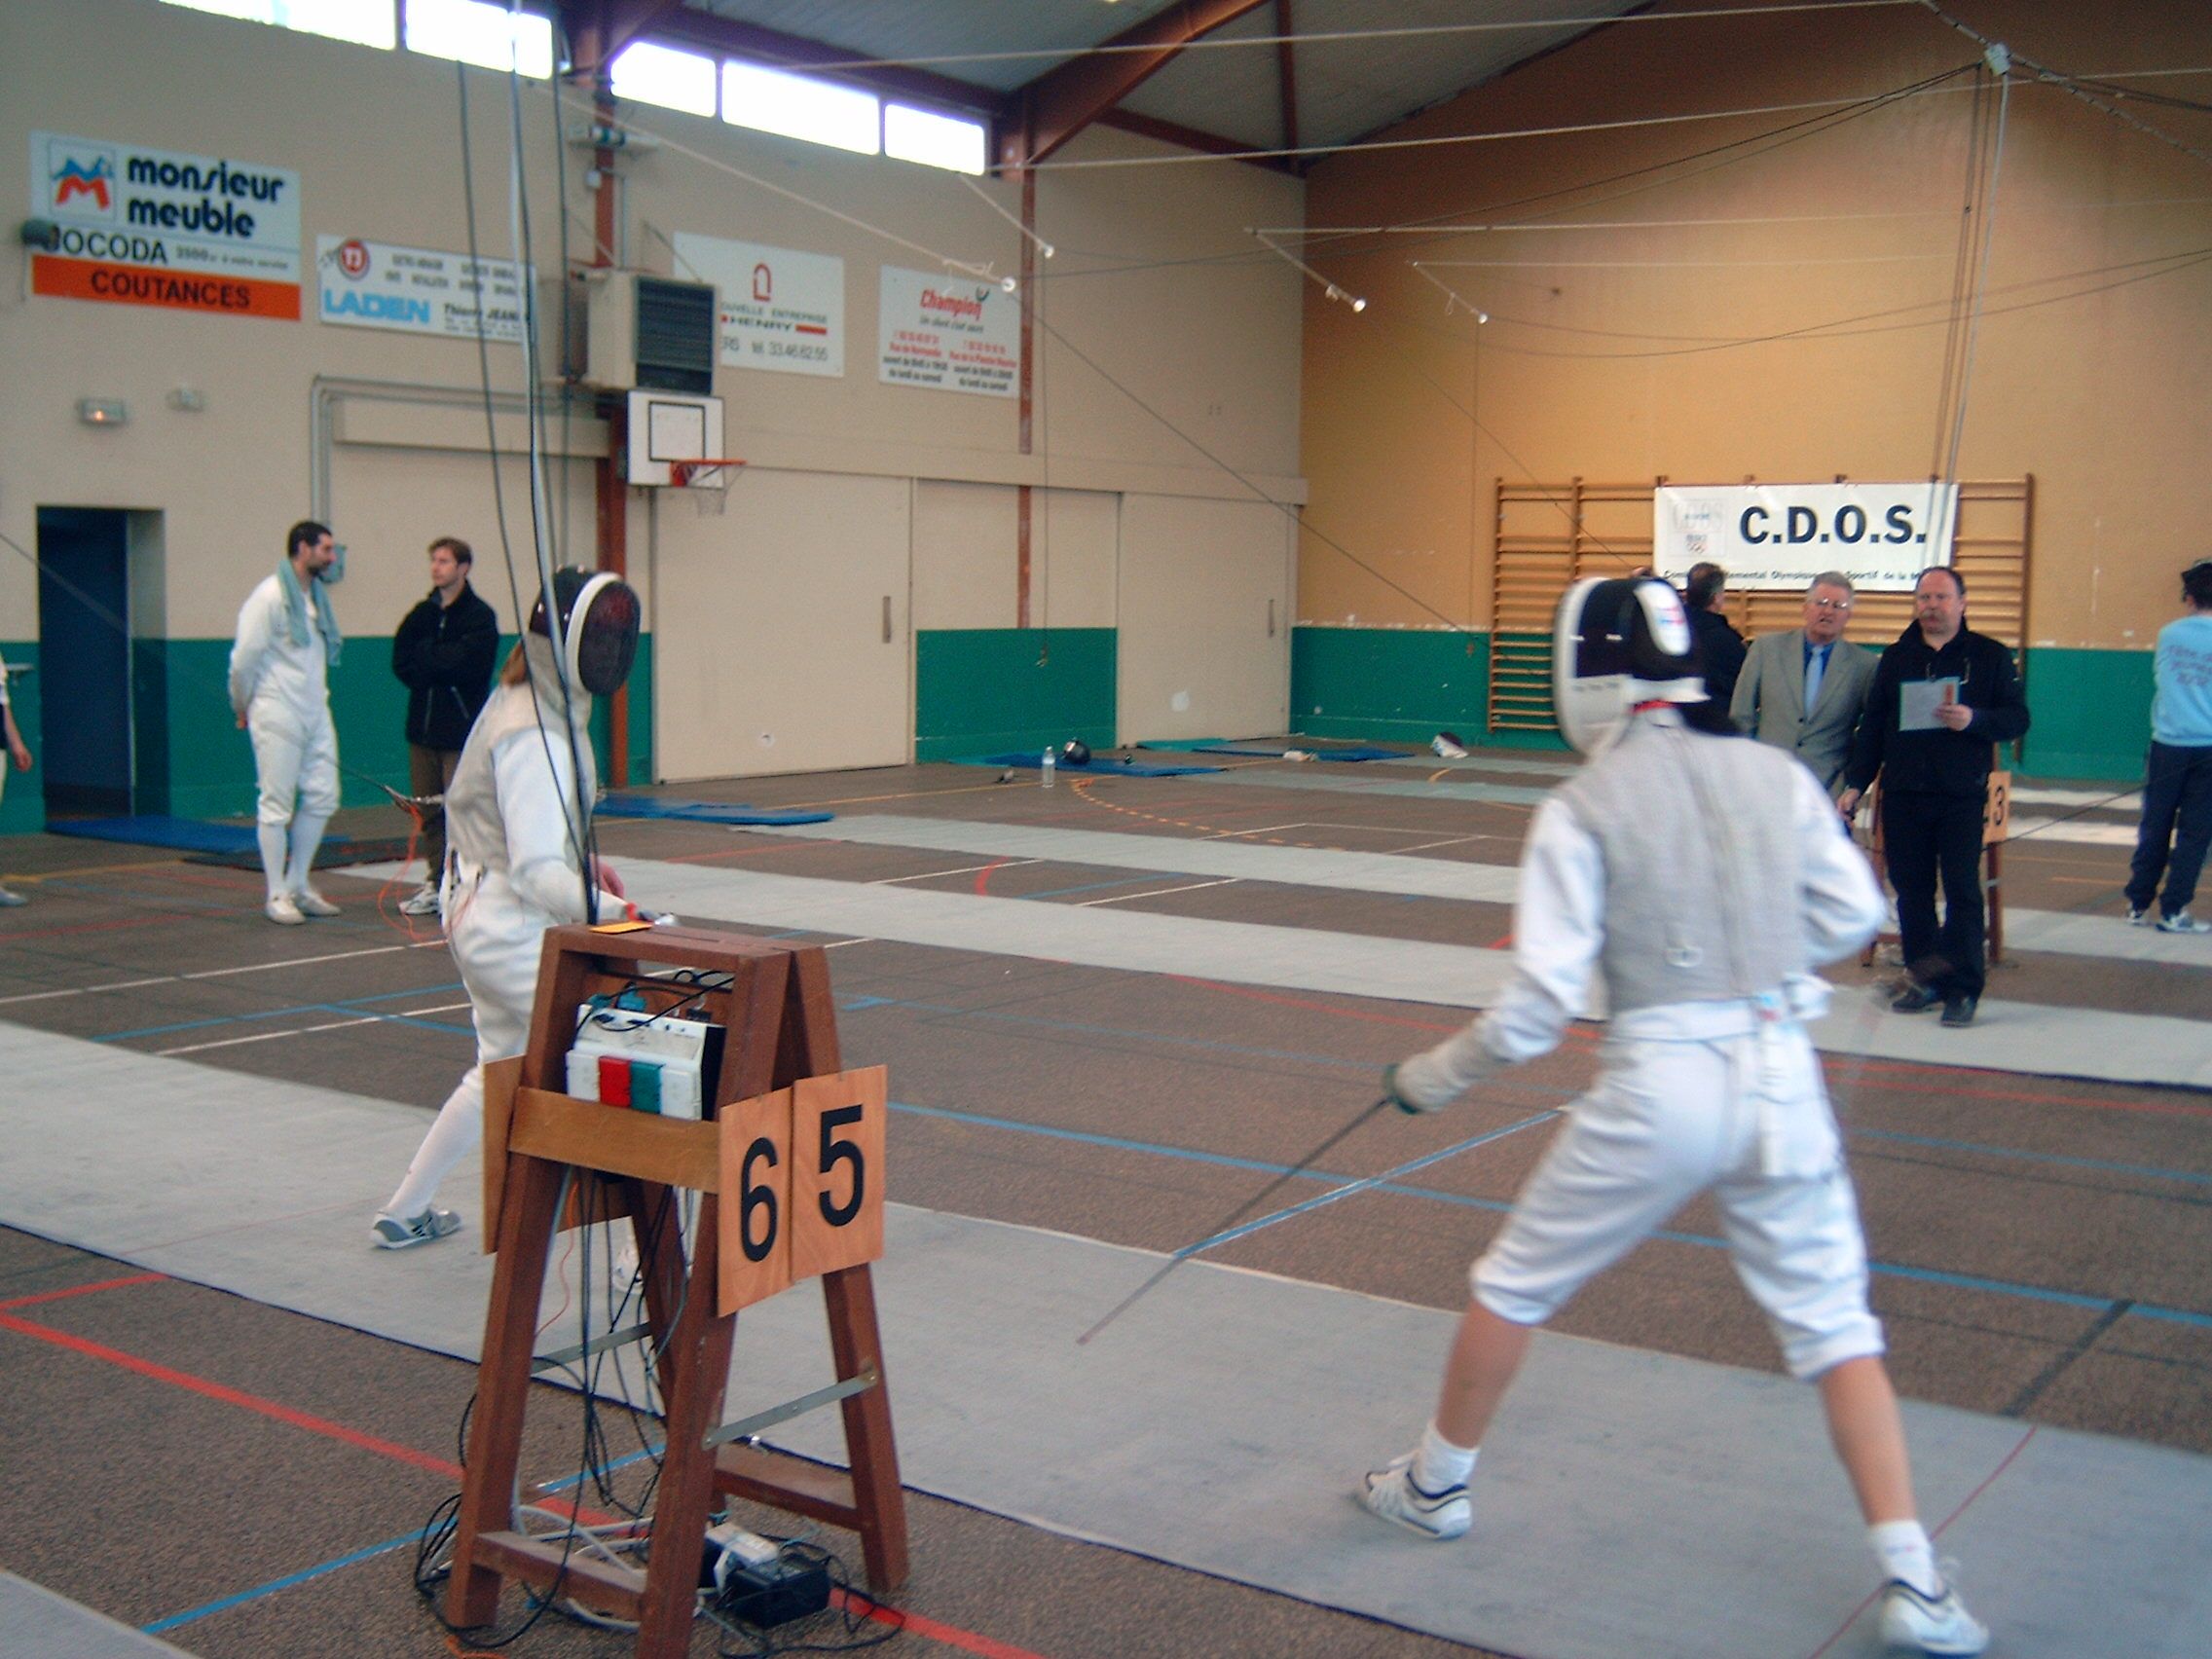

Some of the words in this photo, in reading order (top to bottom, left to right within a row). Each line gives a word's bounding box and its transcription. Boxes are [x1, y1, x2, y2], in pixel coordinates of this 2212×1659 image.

[128, 157, 284, 203] monsieur
[128, 198, 255, 238] meuble
[46, 224, 167, 264] OCODA
[91, 270, 251, 309] COUTANCES
[324, 288, 430, 324] LADEN
[920, 288, 982, 321] Champion
[730, 315, 793, 331] HENRY
[1739, 504, 1927, 544] C.D.O.S.
[740, 1136, 778, 1263] 6
[818, 1104, 865, 1227] 5
